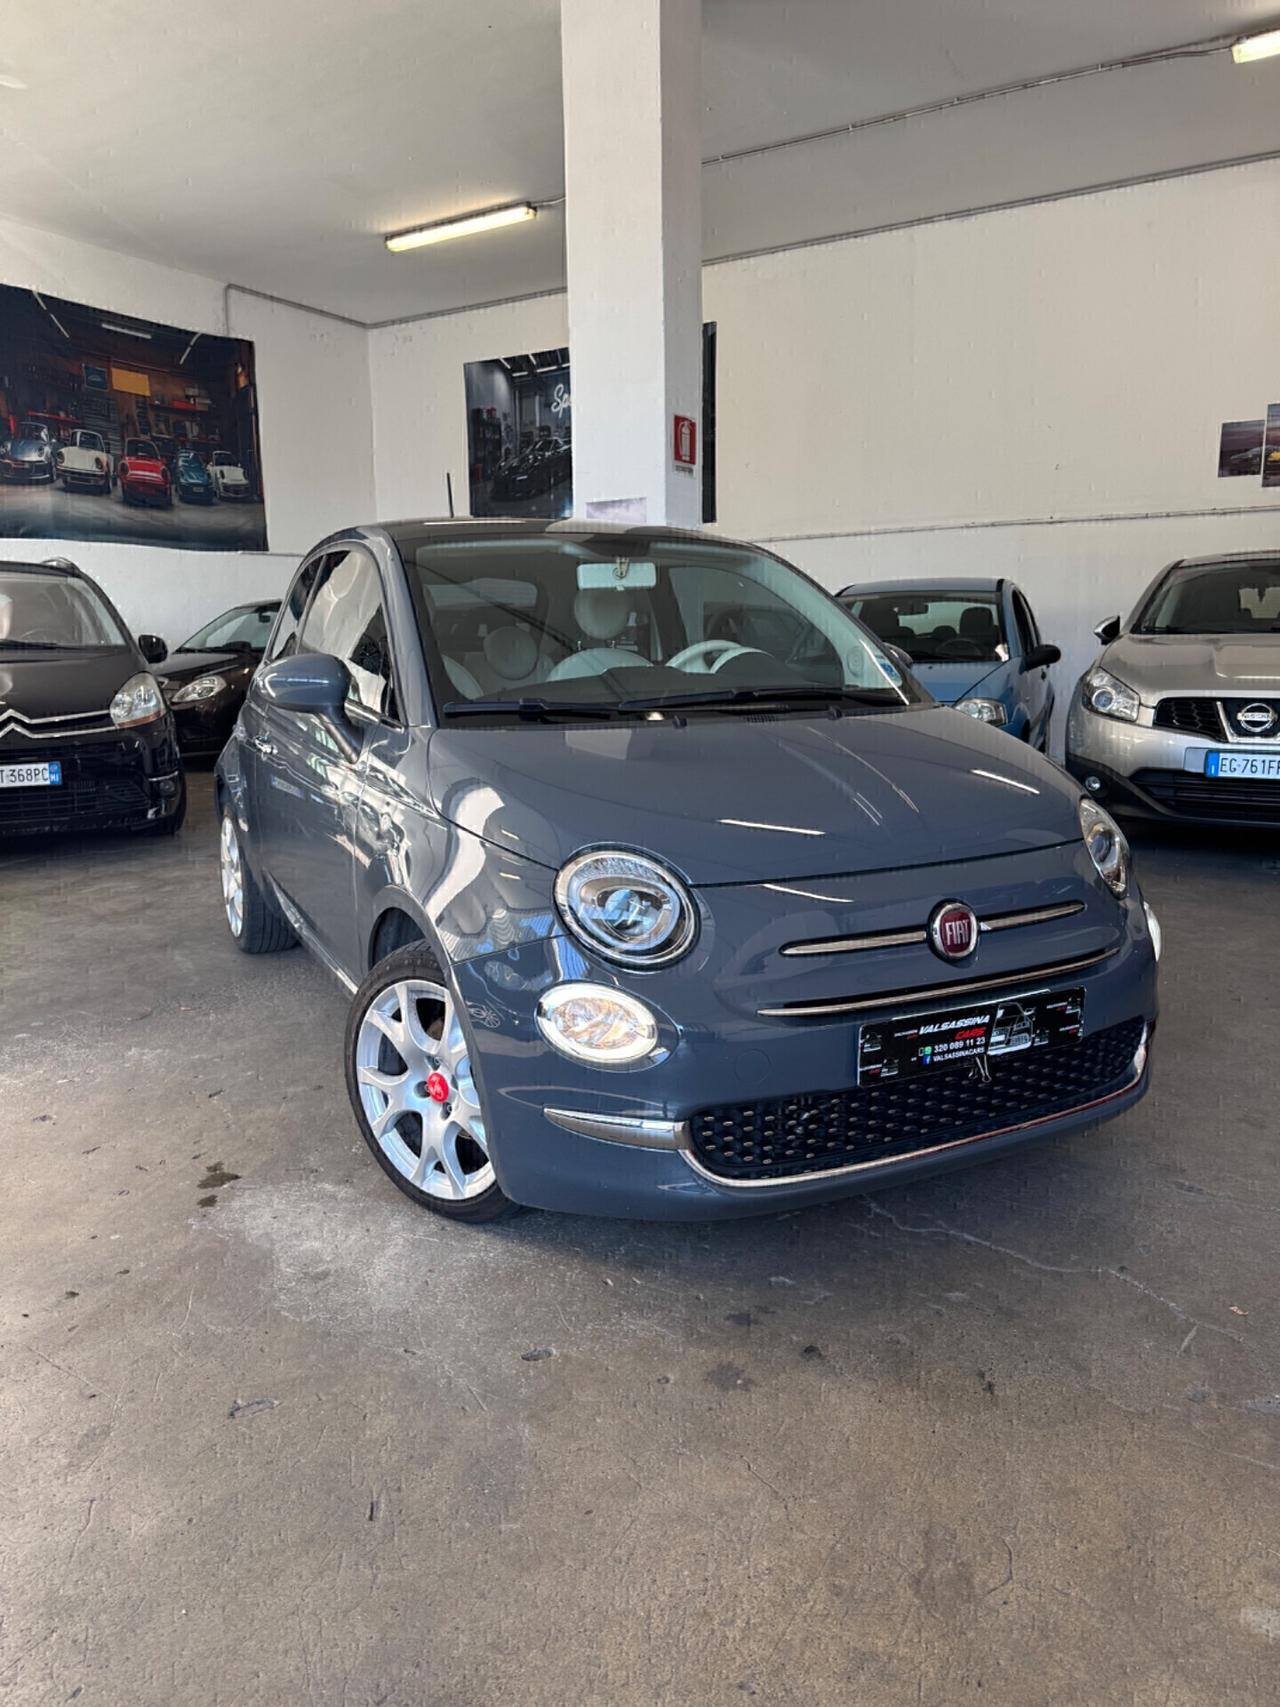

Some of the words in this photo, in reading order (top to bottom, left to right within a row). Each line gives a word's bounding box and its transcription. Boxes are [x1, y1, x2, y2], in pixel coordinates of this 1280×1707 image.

[945, 919, 969, 946] FIAT
[919, 1015, 990, 1035] VALSASSINA
[955, 1027, 986, 1041] CARS
[934, 1044, 948, 1053] 320
